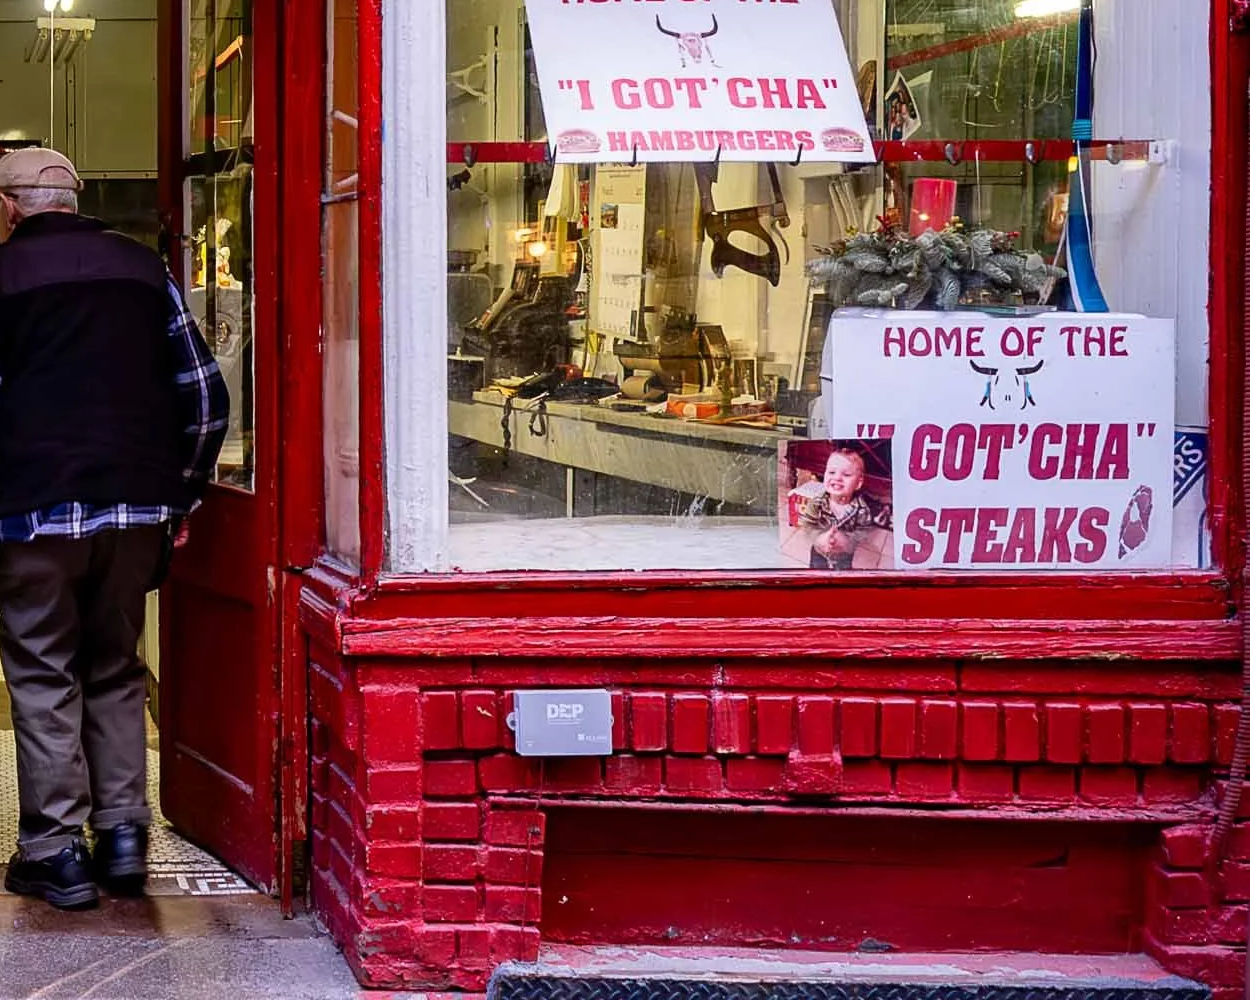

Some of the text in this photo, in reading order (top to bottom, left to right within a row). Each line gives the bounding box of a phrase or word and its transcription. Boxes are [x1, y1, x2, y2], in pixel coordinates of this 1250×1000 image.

[558, 79, 595, 110] "I
[607, 129, 815, 152] HAMBURGERS
[883, 326, 1128, 357] HOME OF THE
[901, 506, 1110, 564] STEAKS
[547, 703, 584, 719] DEP
